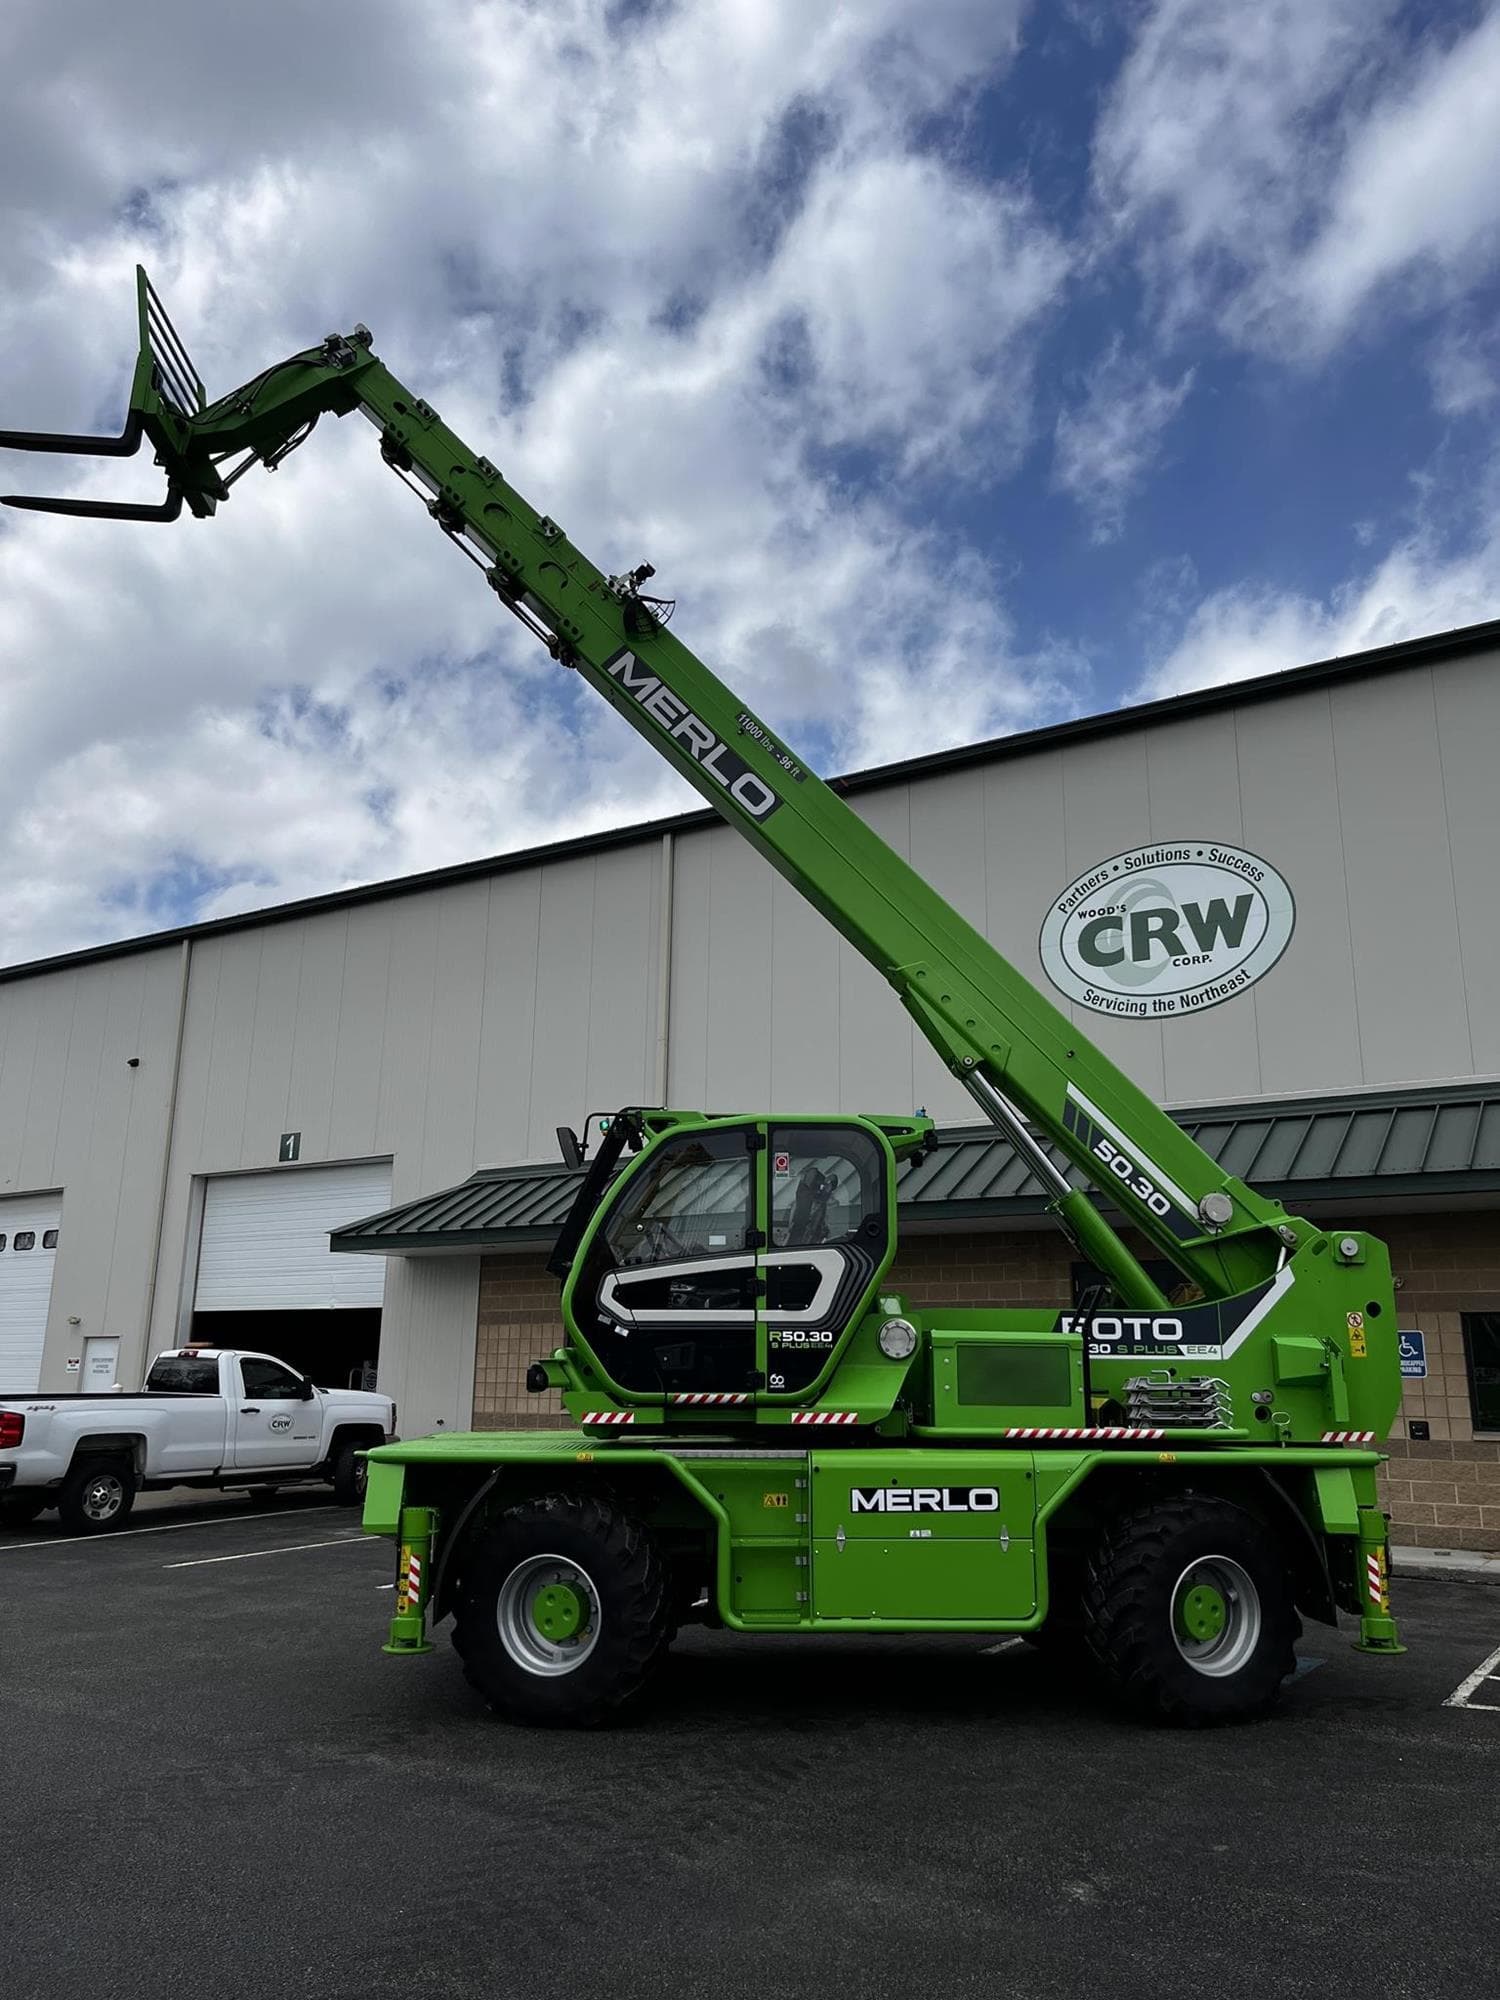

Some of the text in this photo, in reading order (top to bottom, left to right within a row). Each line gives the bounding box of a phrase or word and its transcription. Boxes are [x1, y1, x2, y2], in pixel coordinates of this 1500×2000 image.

[607, 651, 776, 816] MERLO
[739, 714, 763, 739] 11000
[760, 736, 774, 752] lbs
[790, 767, 800, 777] ft
[1058, 848, 1264, 914] Partners Solutions Success
[1078, 904, 1127, 920] WOOD'S
[1077, 893, 1254, 968] CRW
[1172, 954, 1213, 967] CORP.
[1083, 968, 1251, 1016] Servicing the Northeast
[286, 1135, 295, 1159] 1
[1093, 1139, 1171, 1216] 50.30
[769, 1331, 833, 1342] R50.30
[1117, 1345, 1128, 1354] S
[1134, 1345, 1177, 1354] PLUS
[1187, 1345, 1218, 1355] EE4
[271, 1420, 291, 1428] CRW
[851, 1488, 999, 1511] MERLO
